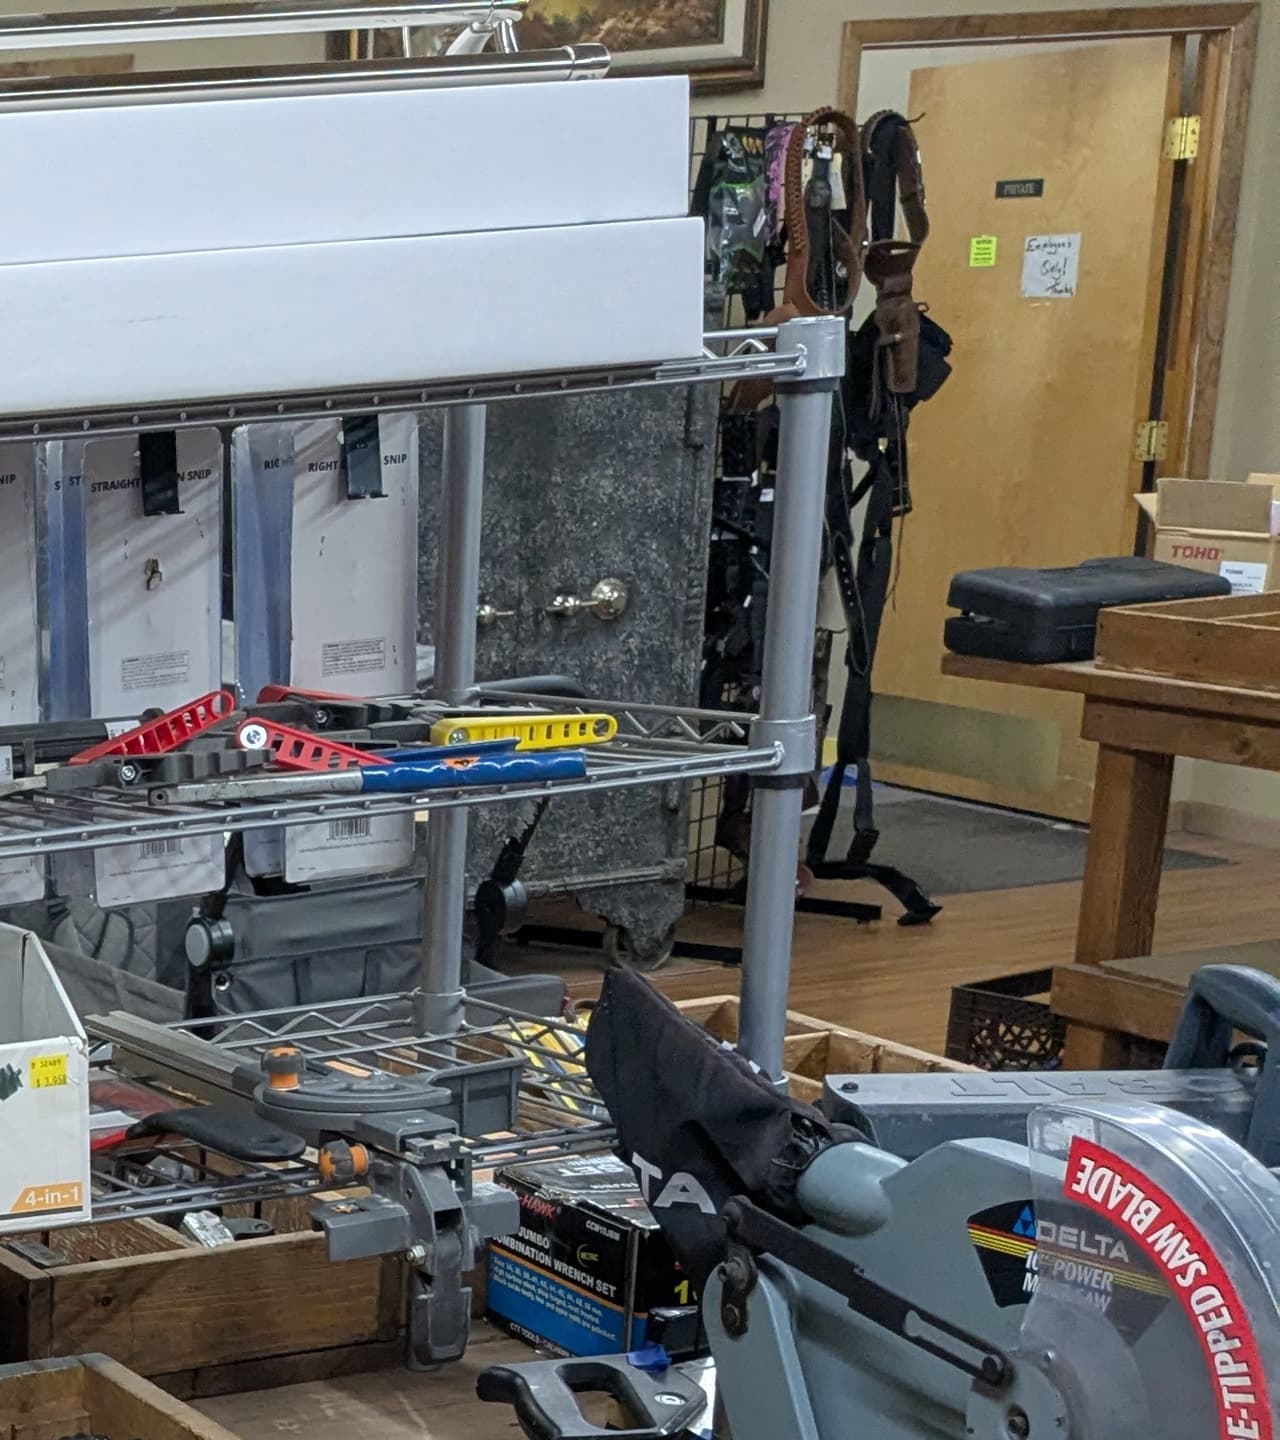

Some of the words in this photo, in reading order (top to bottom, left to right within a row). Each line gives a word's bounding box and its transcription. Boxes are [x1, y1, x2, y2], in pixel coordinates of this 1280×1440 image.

[308, 459, 339, 473] RIGHT
[383, 453, 408, 466] SNIP
[90, 477, 140, 493] STRAIGHT
[186, 468, 212, 482] SNIP
[24, 1185, 81, 1206] 4-in-1
[1071, 1155, 1162, 1231] BLADE
[1146, 1220, 1209, 1288] SAW
[518, 1226, 550, 1249] JUMBO
[1037, 1219, 1130, 1263] DELTA
[553, 1259, 595, 1288] WRENCH
[595, 1279, 617, 1299] SET
[1052, 1259, 1114, 1292] POWER
